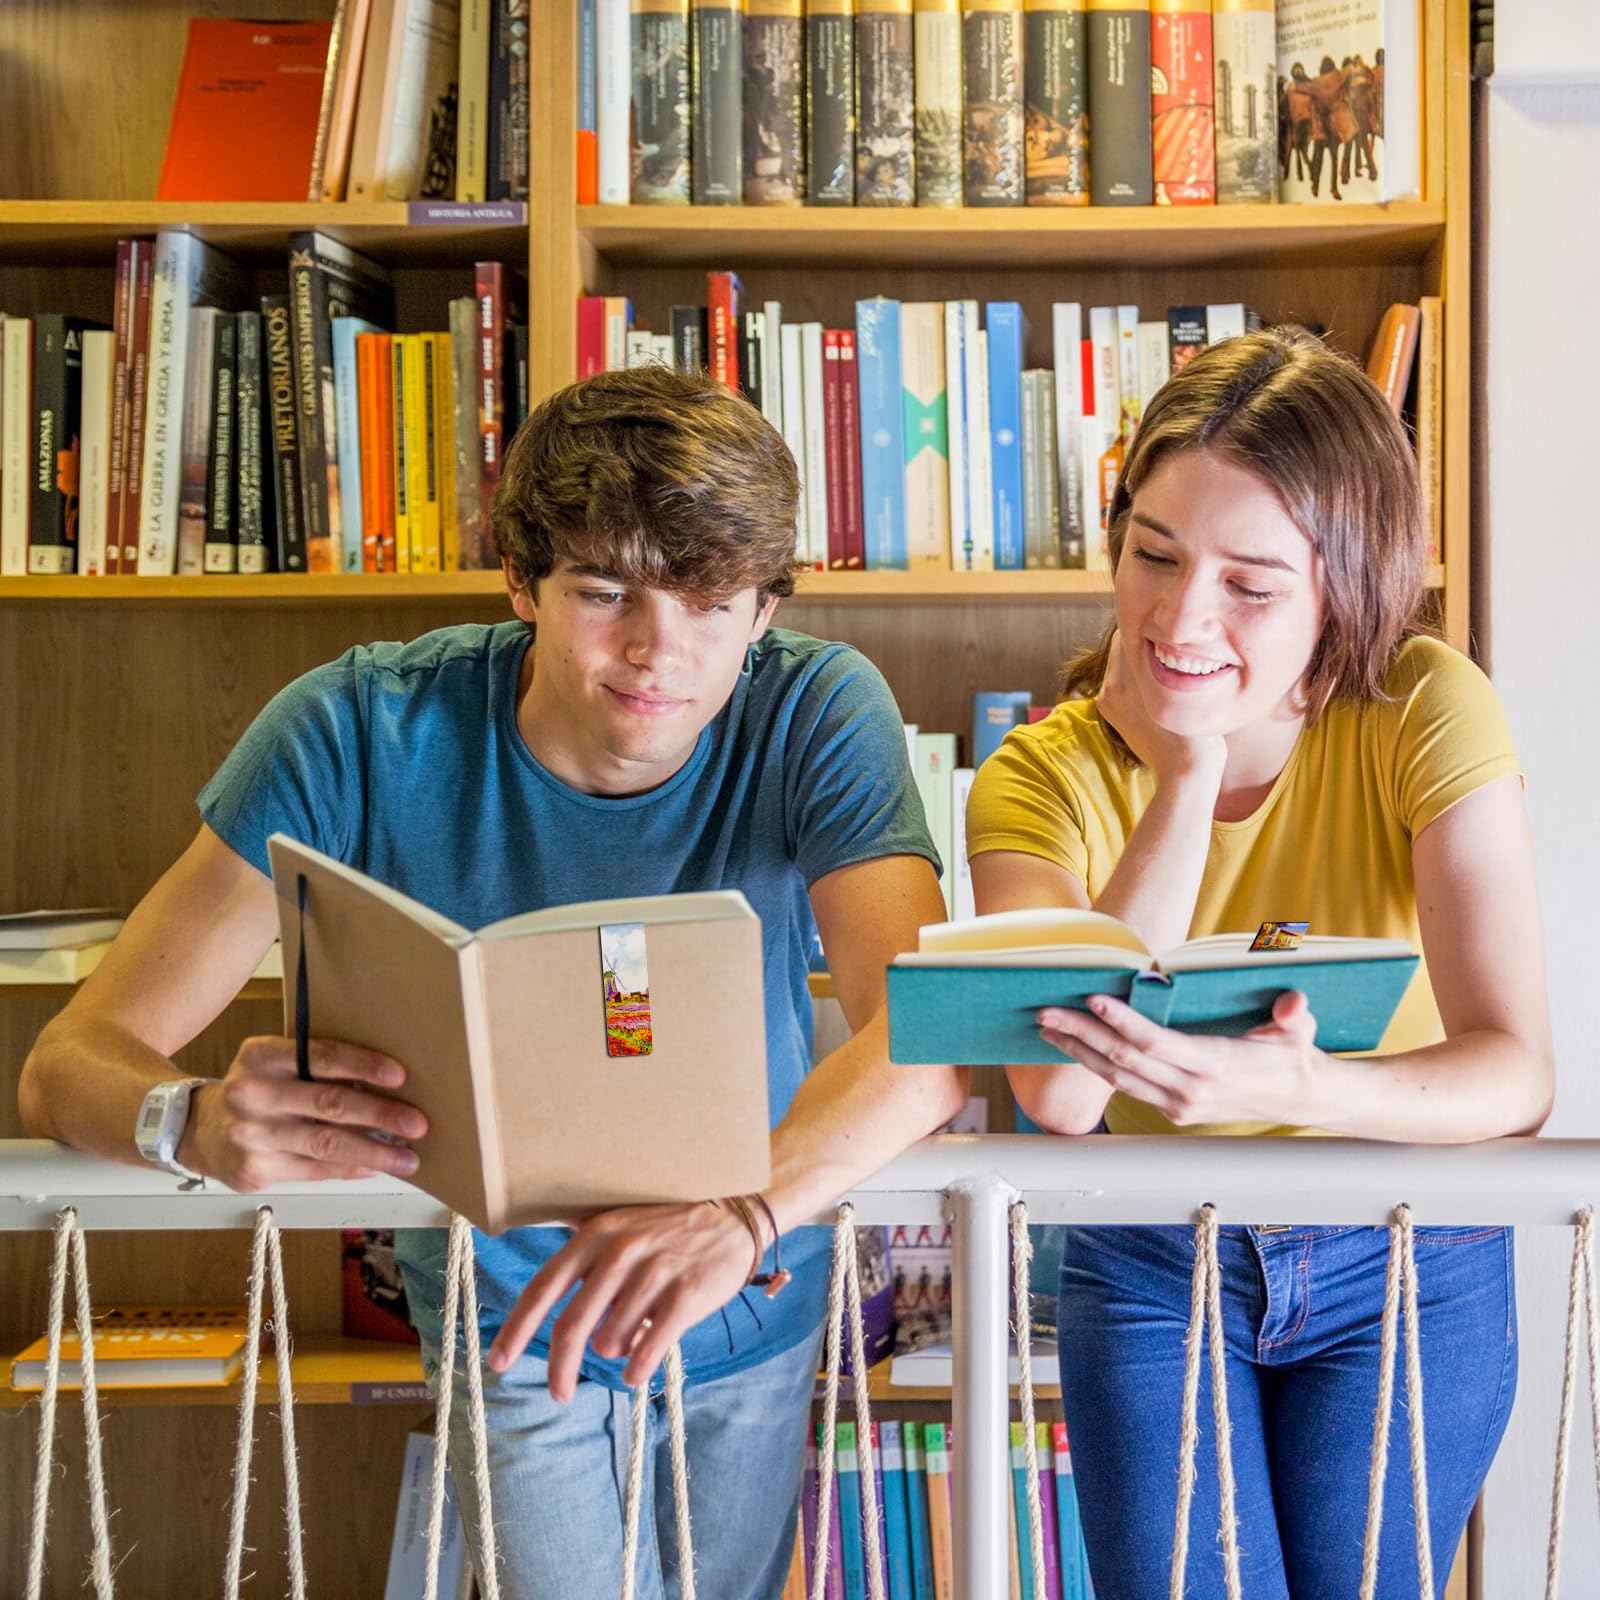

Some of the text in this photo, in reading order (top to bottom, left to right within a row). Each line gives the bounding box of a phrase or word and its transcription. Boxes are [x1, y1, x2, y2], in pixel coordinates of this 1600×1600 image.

[428, 208, 514, 218] HISTORIA ANTIGUA
[149, 299, 174, 533] LA GUERRA EN GRECIA Y ROMA
[267, 307, 295, 452] PRETORIANOS
[297, 271, 316, 416] GRANDES IMPERIOS
[38, 409, 54, 493] AMAZONAS
[213, 368, 231, 530] EQUIPAMIENTO MILITAR ROMANO
